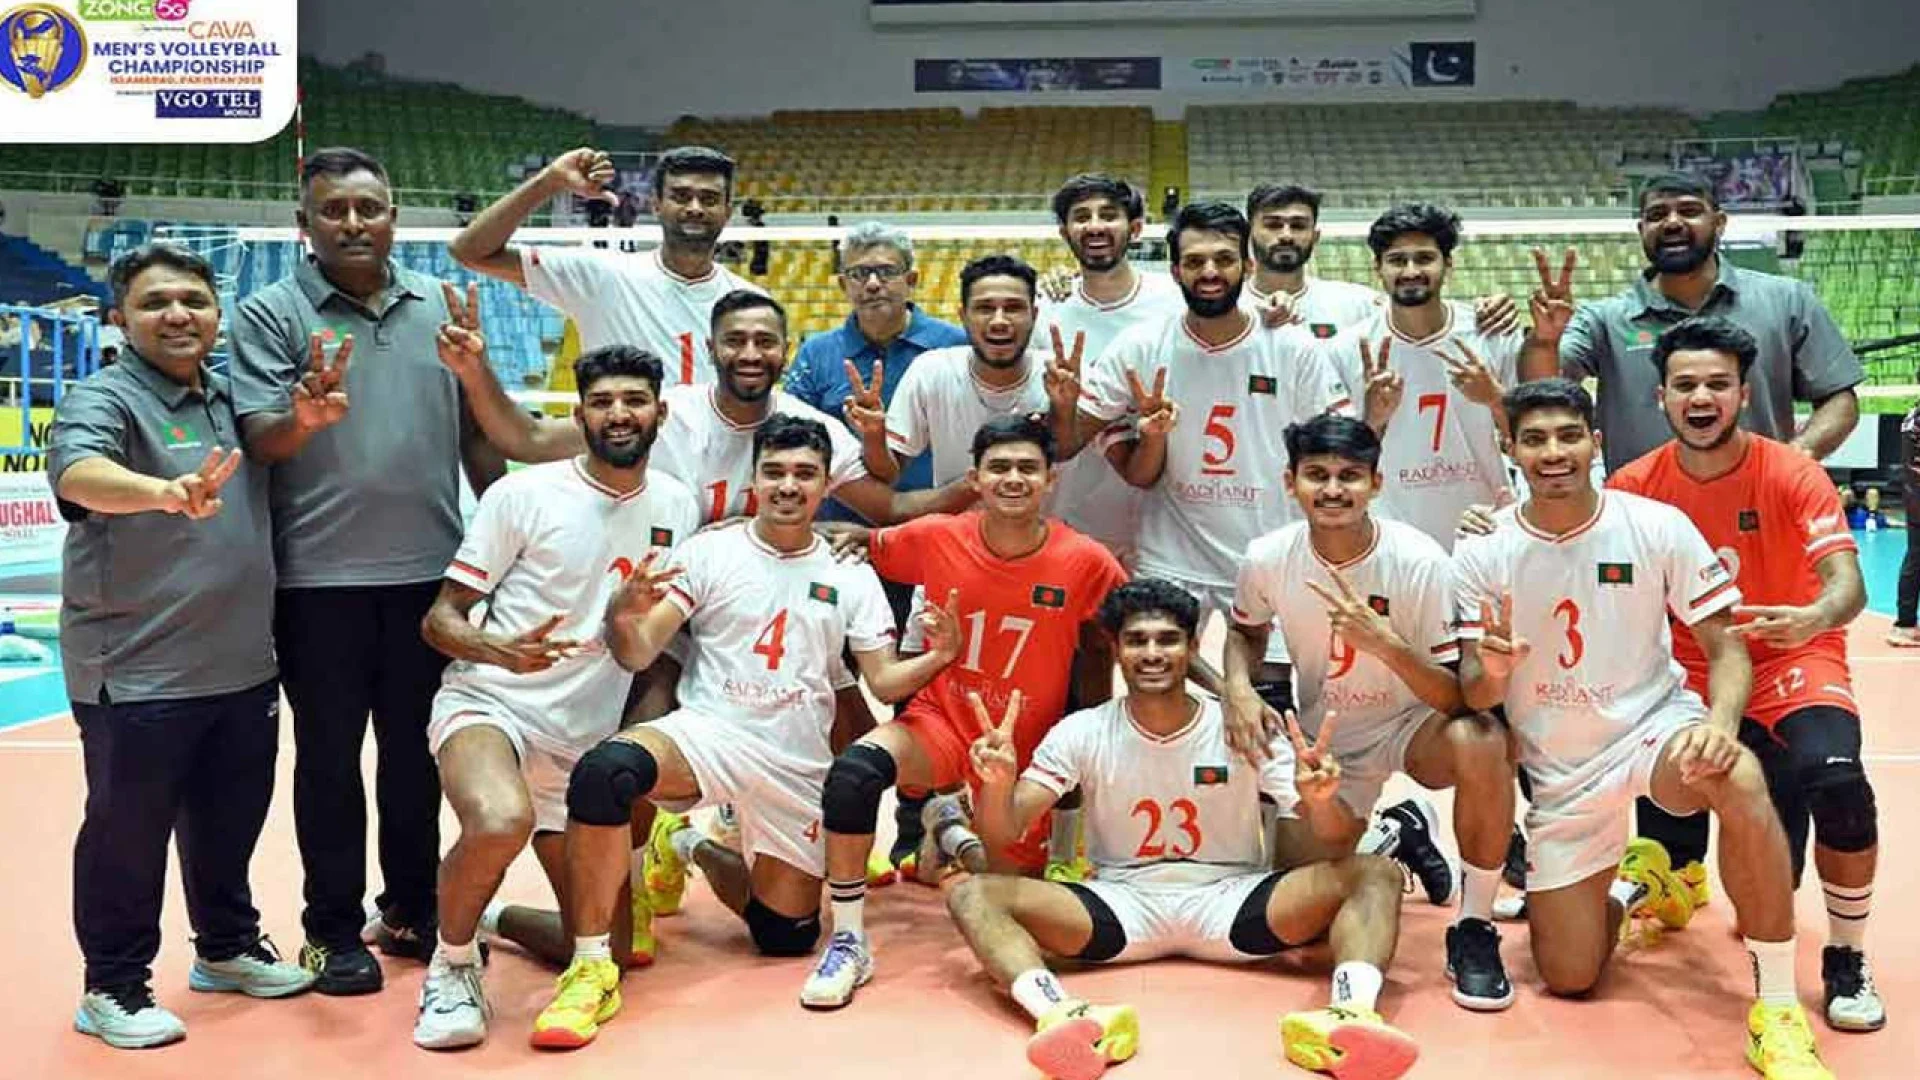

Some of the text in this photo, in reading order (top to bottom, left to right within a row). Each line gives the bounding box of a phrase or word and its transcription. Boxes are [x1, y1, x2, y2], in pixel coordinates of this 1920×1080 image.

[1203, 405, 1236, 466] 5
[1418, 394, 1447, 453] 7
[706, 480, 760, 522] 11
[753, 608, 787, 669] 4
[960, 609, 1036, 679] 17
[1553, 599, 1584, 669] 3
[1773, 667, 1805, 698] 12
[804, 819, 820, 843] 4
[1131, 799, 1202, 858] 23
